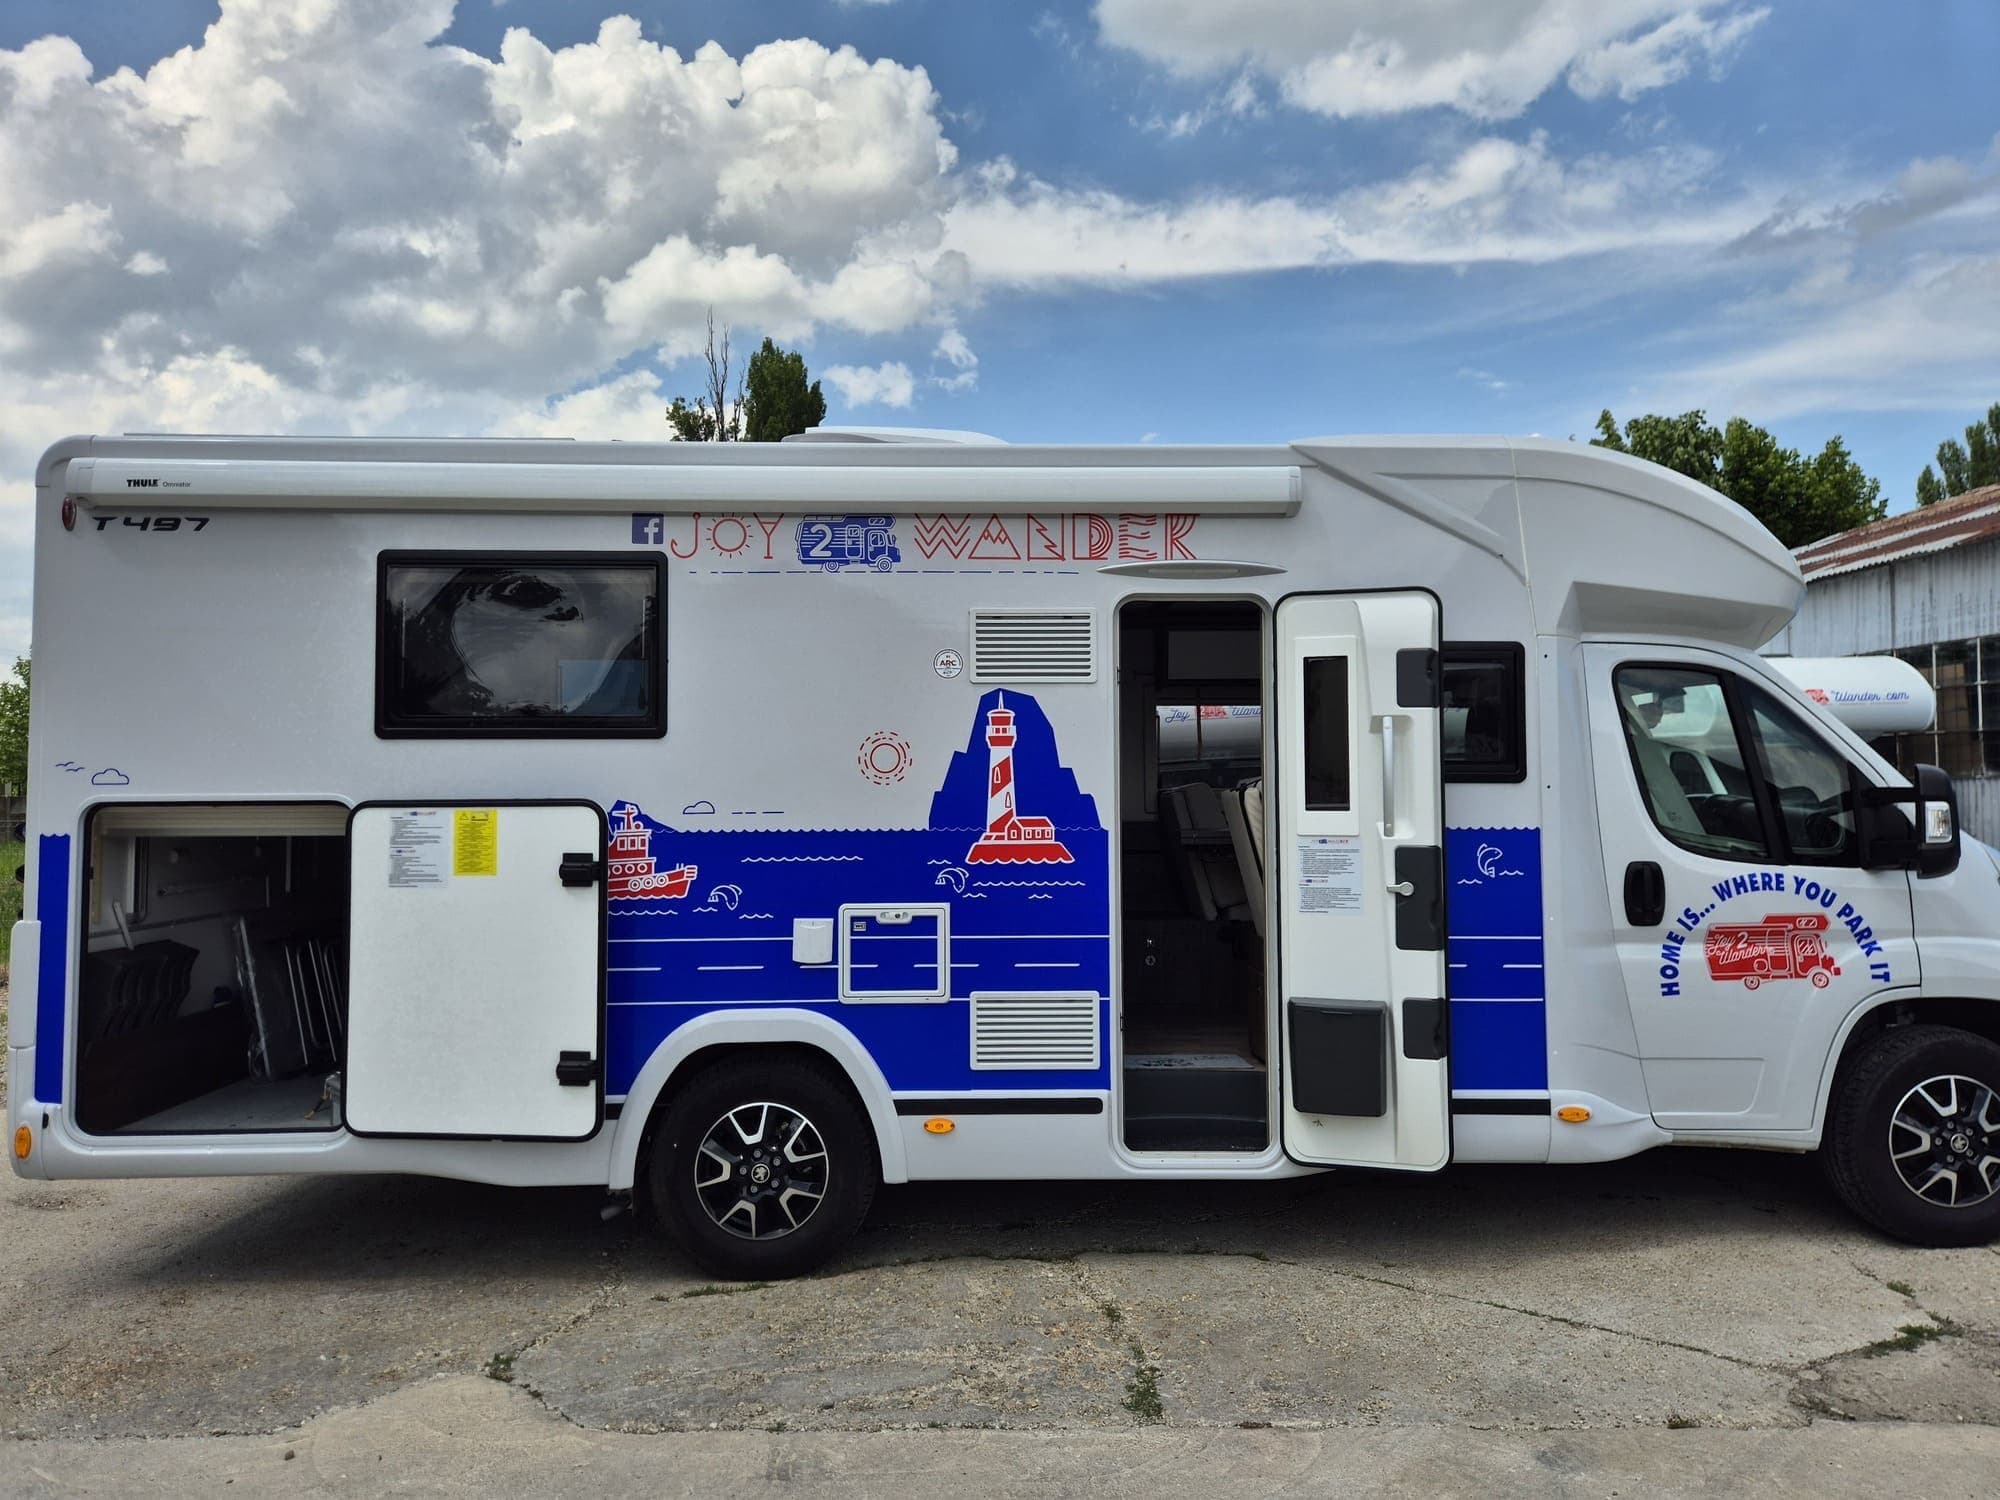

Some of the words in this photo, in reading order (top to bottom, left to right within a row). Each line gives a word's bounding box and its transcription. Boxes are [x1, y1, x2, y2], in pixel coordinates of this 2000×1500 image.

[126, 479, 159, 487] THULE
[670, 512, 785, 560] JOY
[809, 525, 833, 557] 2
[914, 513, 1199, 560] WANDER
[1660, 931, 1685, 996] HOME
[1712, 872, 1785, 901] WHERE
[1793, 875, 1838, 909] YOU
[1836, 902, 1883, 957] PARK
[1870, 962, 1890, 982] IT
[1737, 931, 1749, 949] 2
[1716, 945, 1766, 965] Wander
